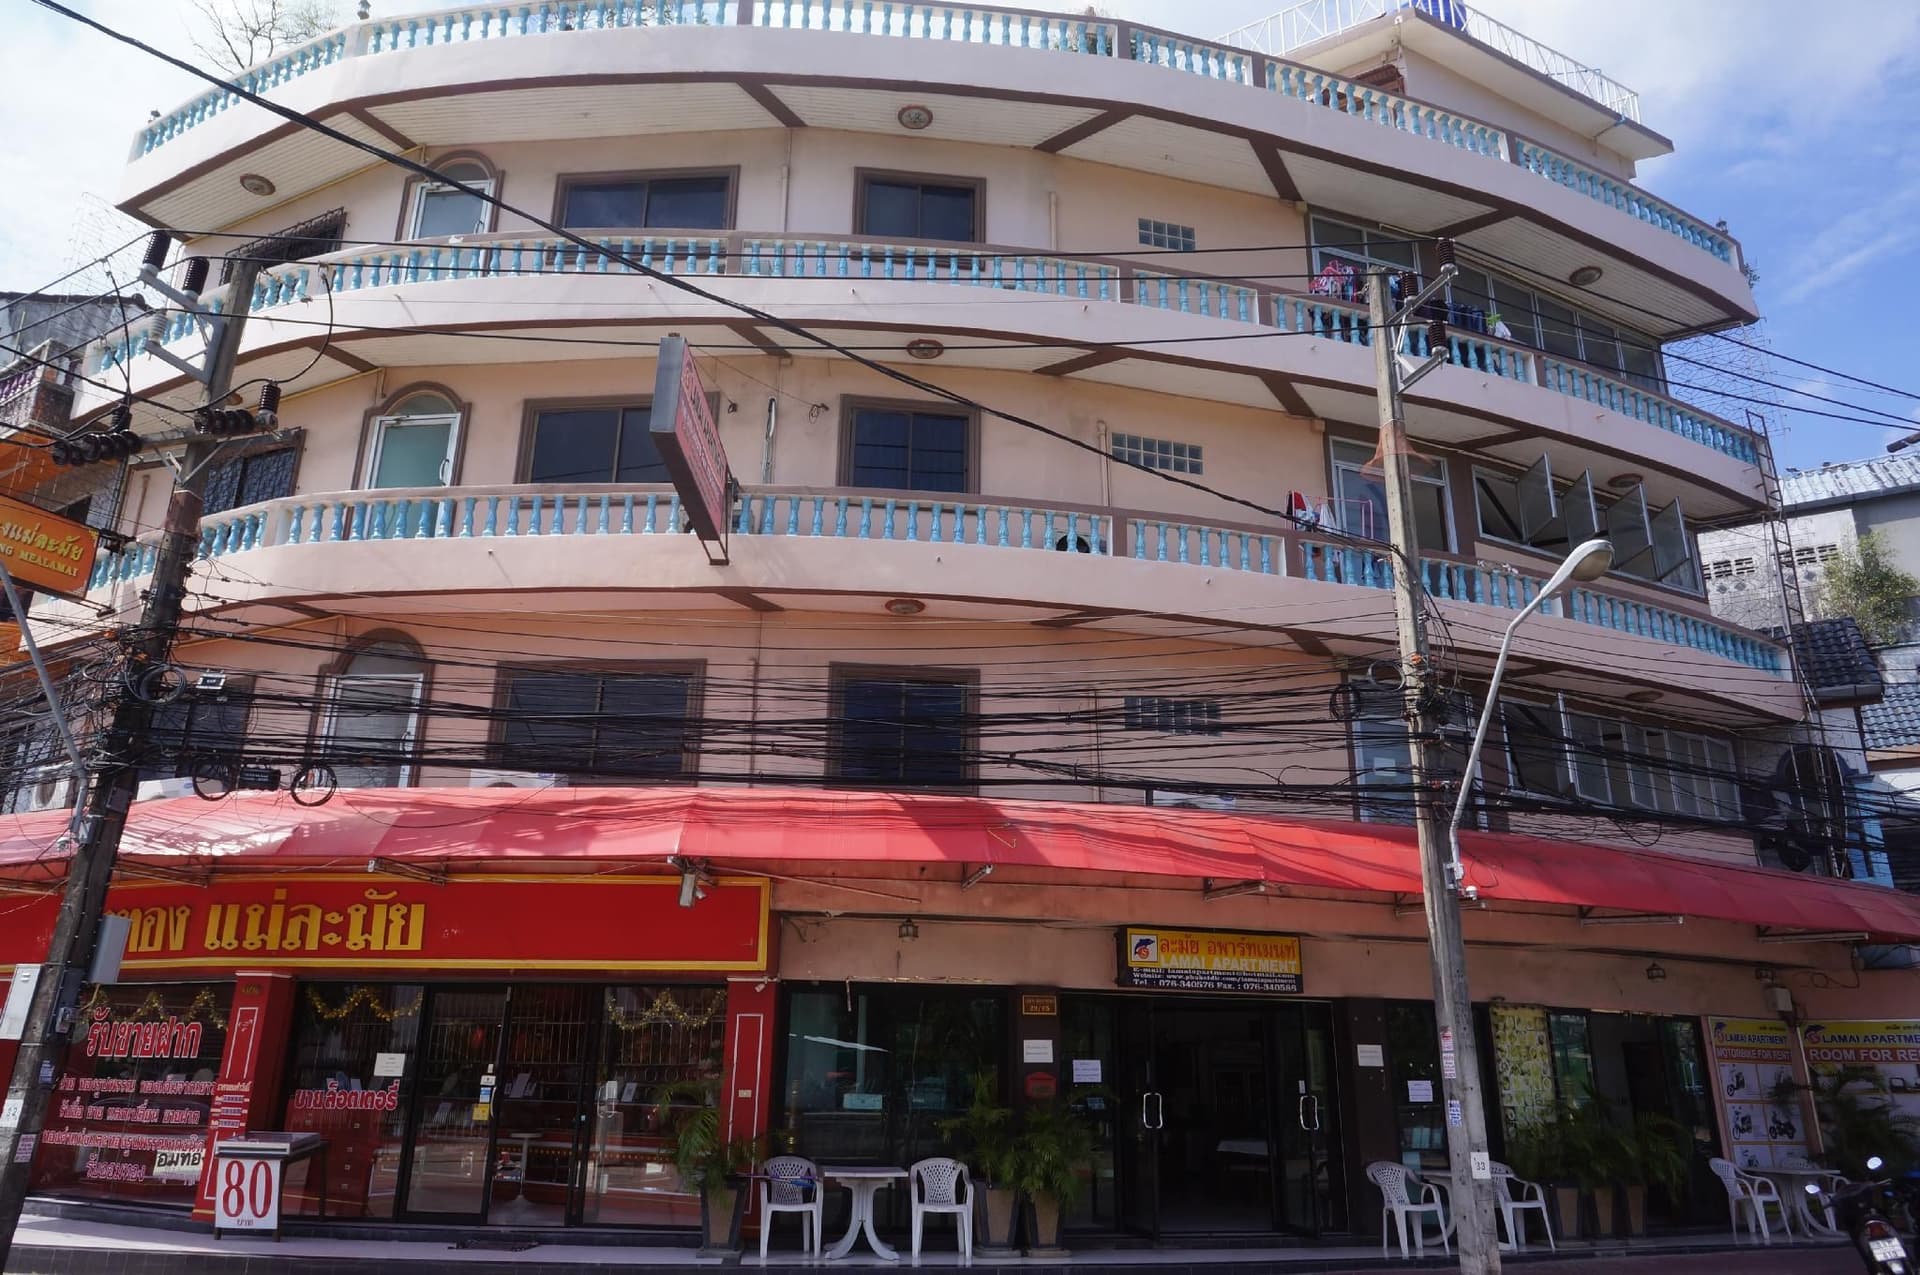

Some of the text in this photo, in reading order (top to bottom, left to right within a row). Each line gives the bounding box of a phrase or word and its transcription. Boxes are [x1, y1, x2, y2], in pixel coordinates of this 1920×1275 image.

[0, 522, 84, 561] งแม่ละมัย
[104, 888, 426, 952] ทอง แม่ละมัย
[1160, 955, 1297, 974] LAMAI APARTMENT
[87, 1007, 202, 1058] รับขายฝาก
[1823, 1034, 1860, 1043] LAMAI
[1809, 1049, 1920, 1061] ROOM FOR RE
[157, 1151, 206, 1167] อมทอ
[223, 1160, 273, 1218] 80
